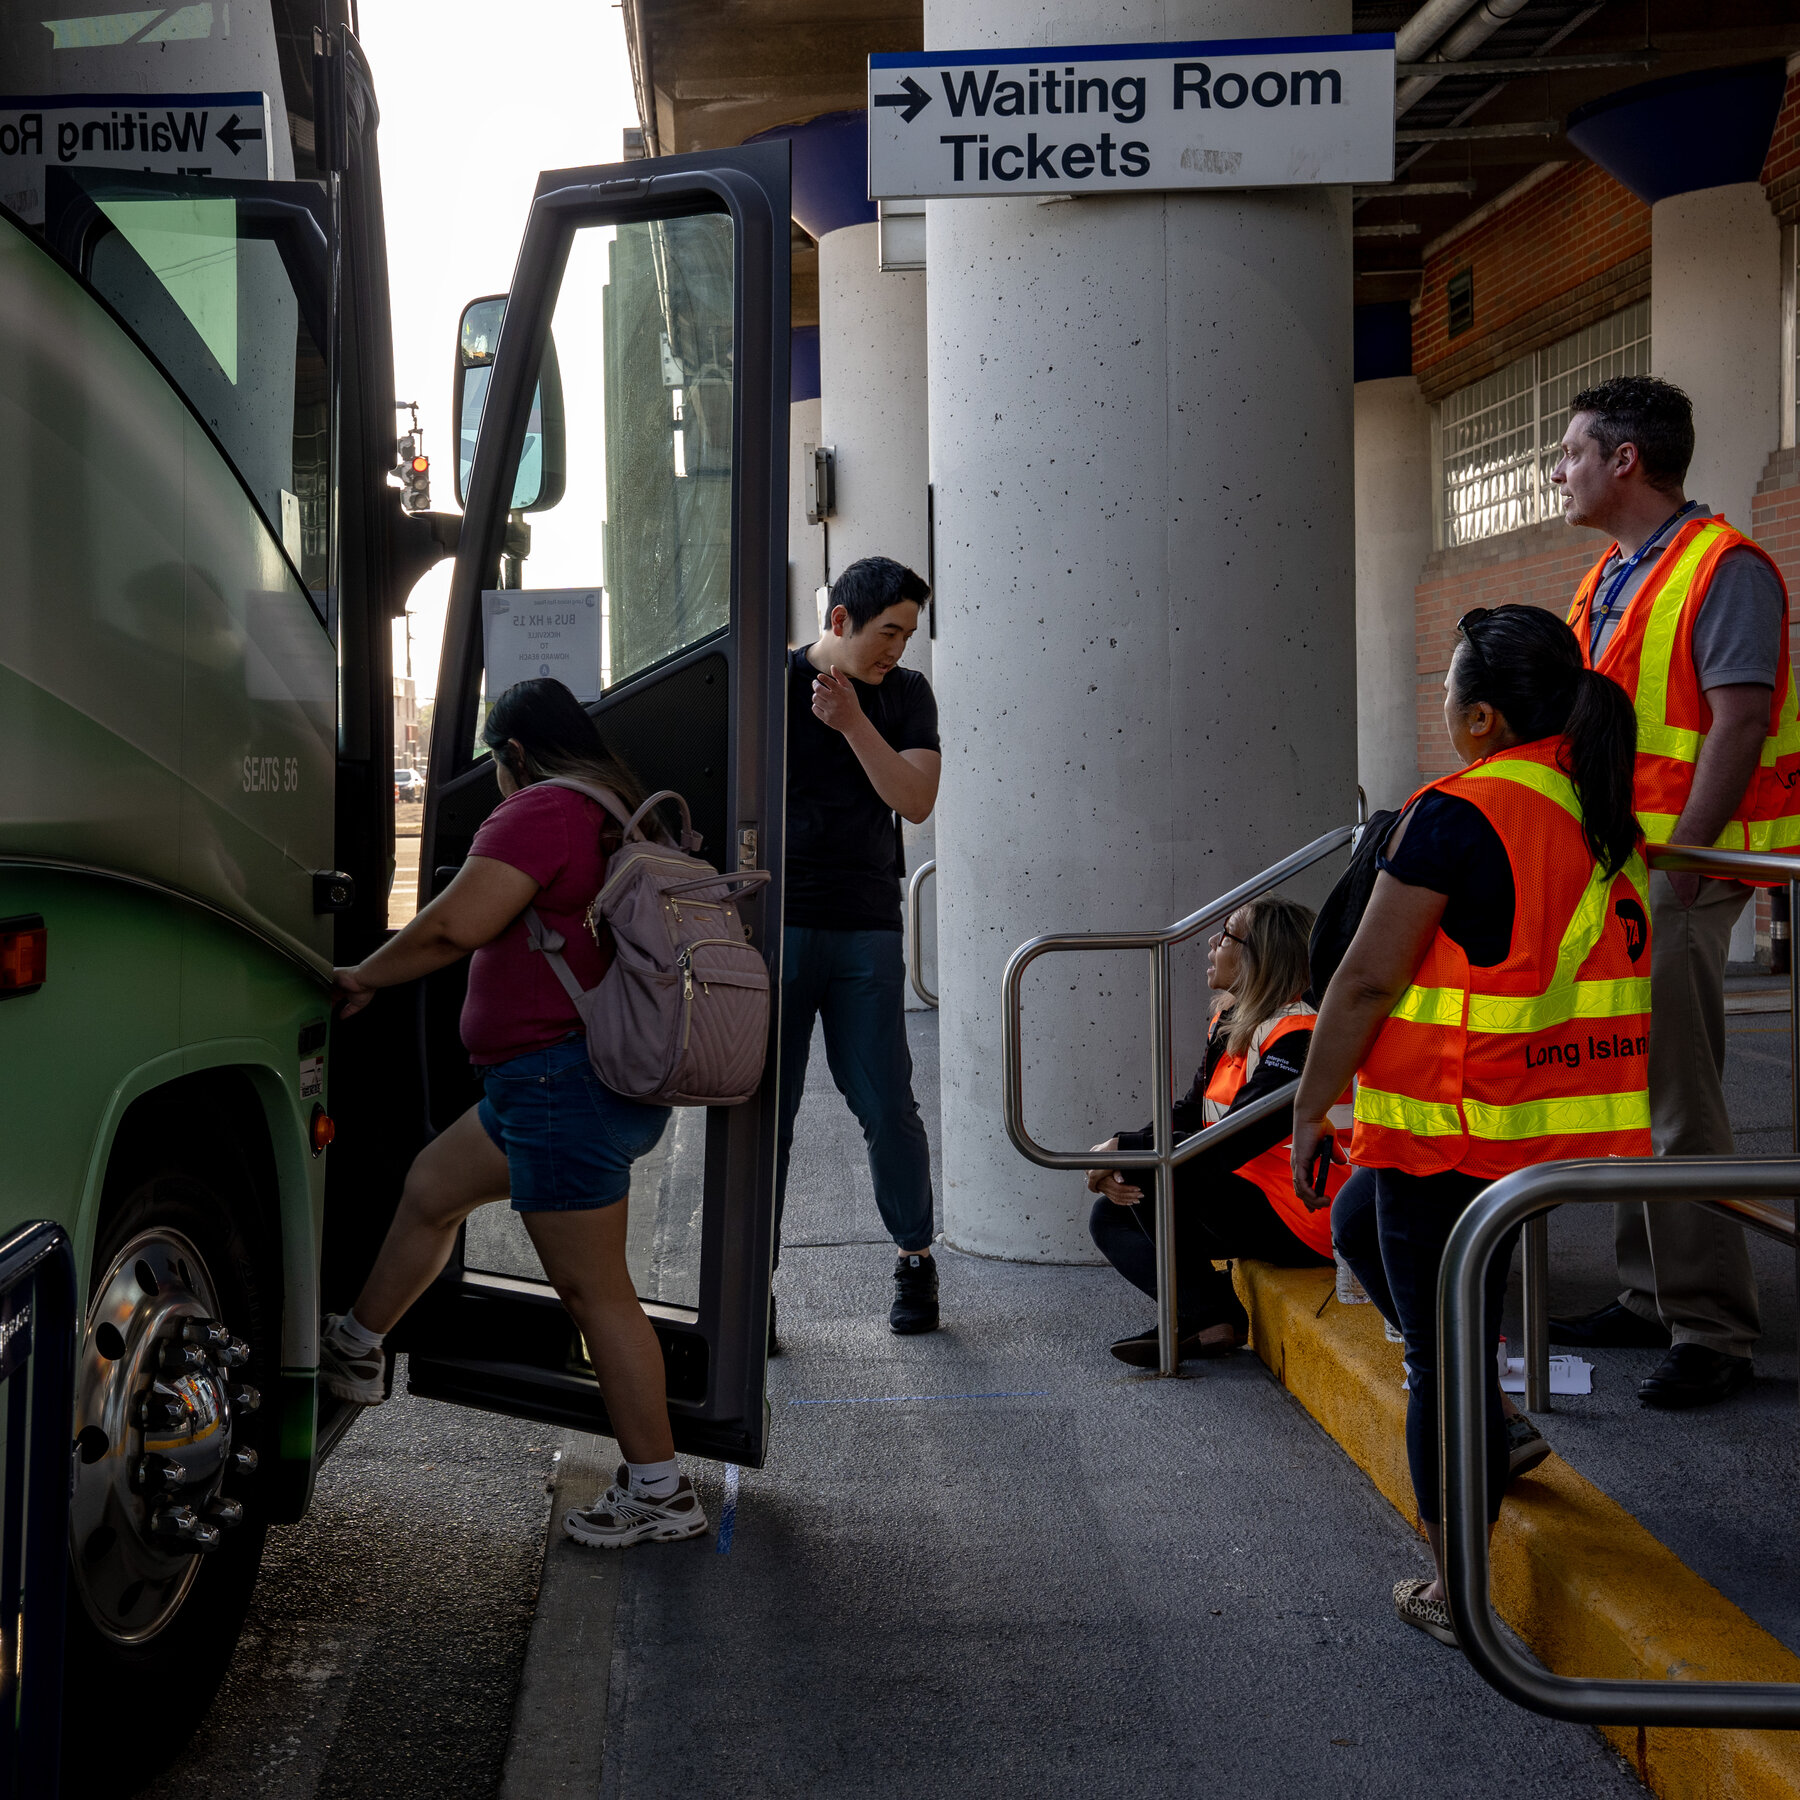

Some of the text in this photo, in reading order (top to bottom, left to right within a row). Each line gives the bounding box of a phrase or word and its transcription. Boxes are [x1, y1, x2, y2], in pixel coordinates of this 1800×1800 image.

[940, 62, 1341, 124] Waiting Room
[939, 132, 1151, 182] Tickets
[243, 756, 298, 792] SEATS 56
[1266, 1055, 1289, 1065] Enterprise
[1526, 1034, 1649, 1069] Long Islan
